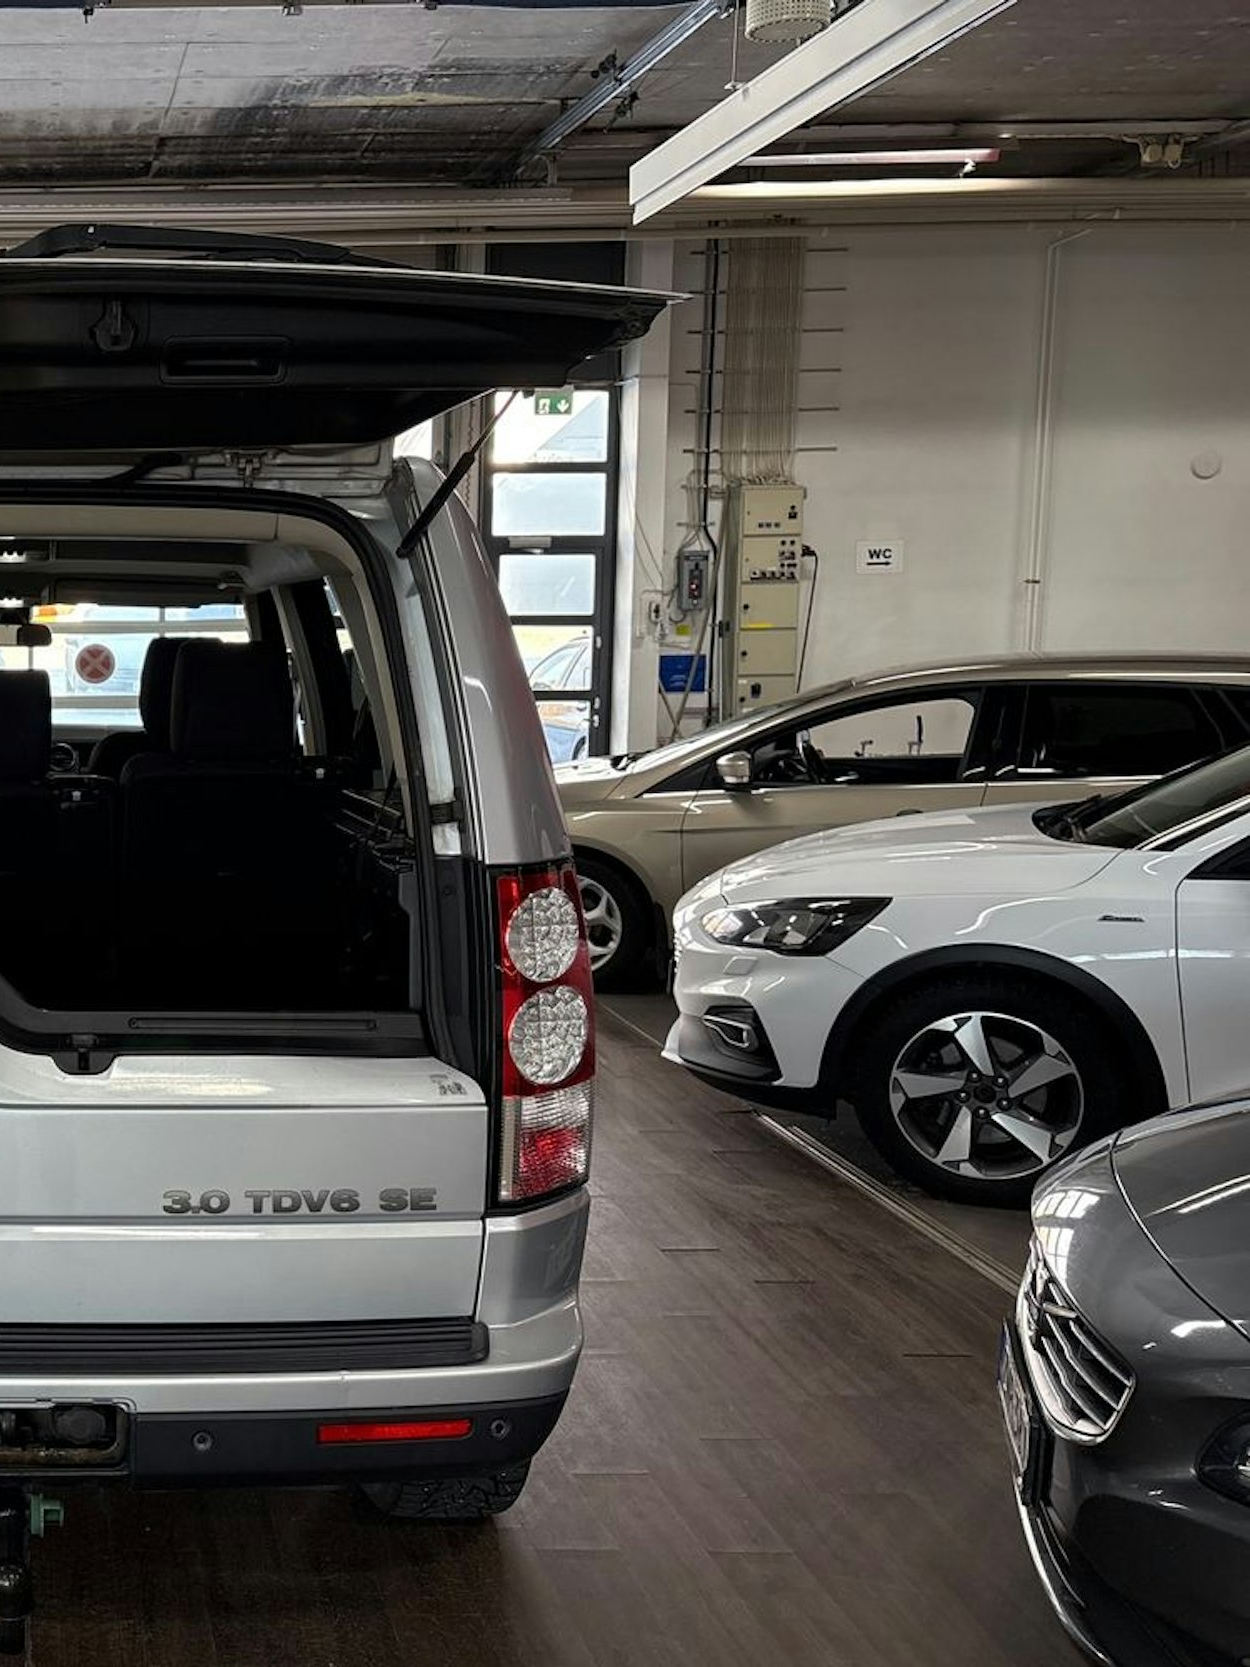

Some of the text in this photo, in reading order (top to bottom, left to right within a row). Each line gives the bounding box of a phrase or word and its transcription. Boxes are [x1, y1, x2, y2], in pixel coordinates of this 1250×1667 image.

[867, 548, 892, 559] WC
[162, 1187, 438, 1214] 3.0 TDV6 SE
